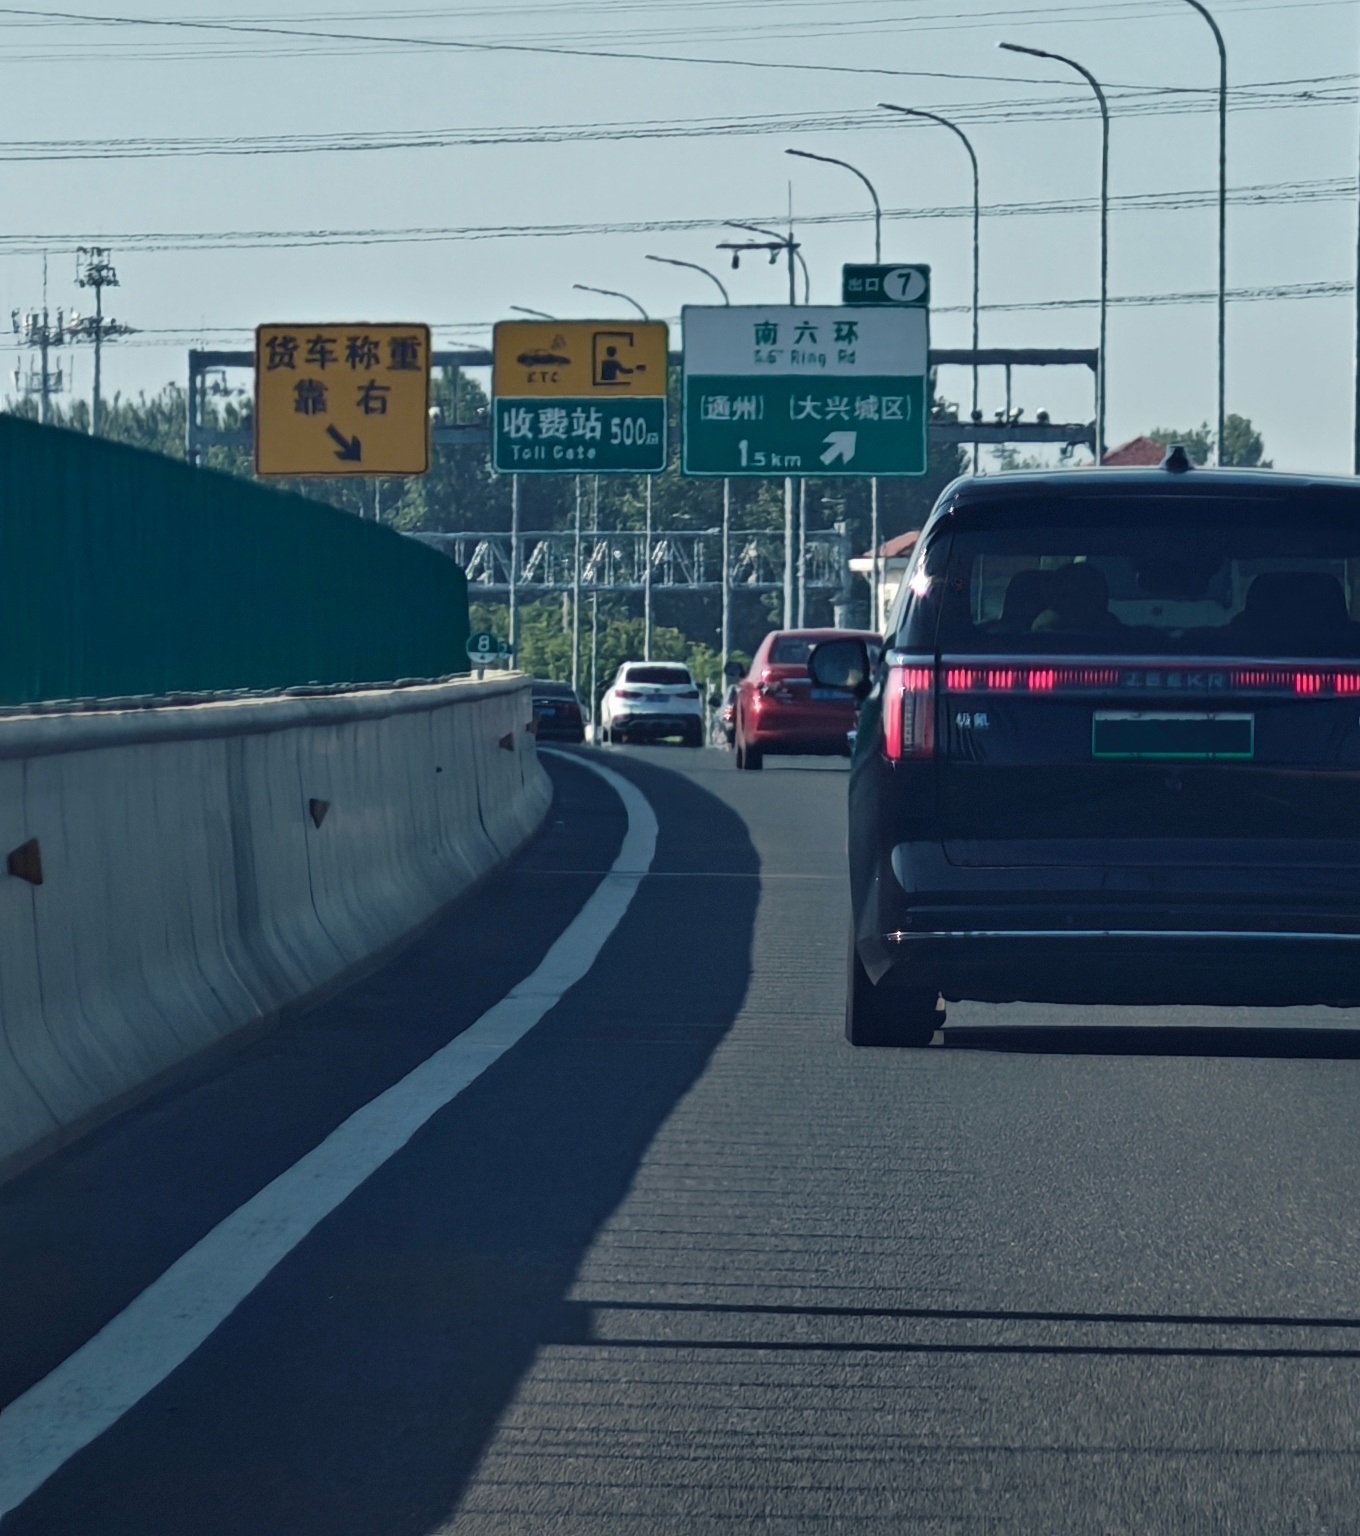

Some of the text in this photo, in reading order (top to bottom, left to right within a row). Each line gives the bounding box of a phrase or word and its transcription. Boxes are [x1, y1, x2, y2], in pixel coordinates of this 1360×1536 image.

[848, 271, 912, 297] 出口 7
[753, 320, 859, 346] 南六环
[265, 334, 423, 372] 货车称重
[791, 349, 826, 368] Ring
[503, 407, 602, 440] 收费站
[511, 444, 597, 461] Toll Gate
[477, 634, 490, 652] 8
